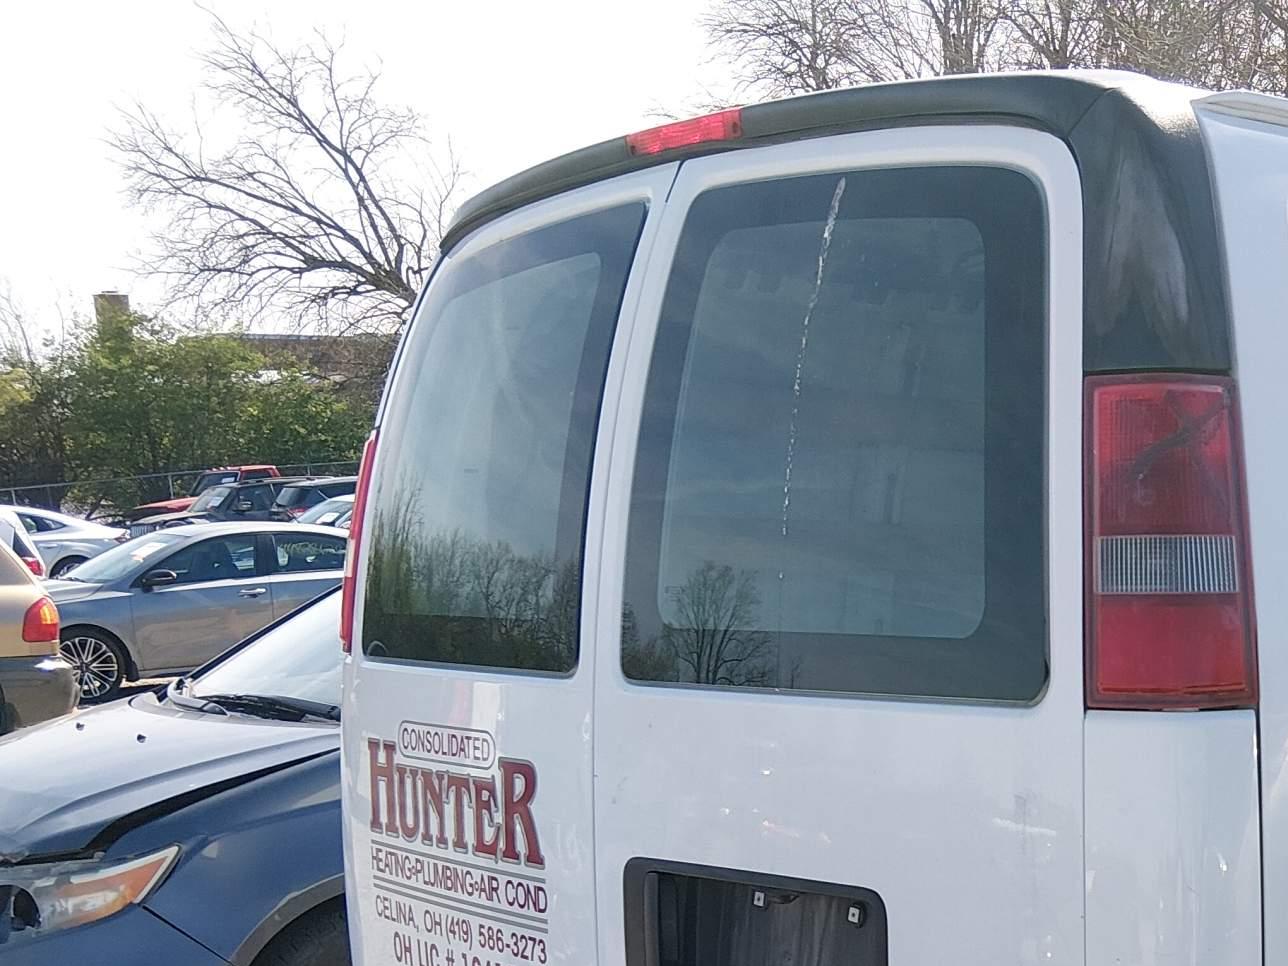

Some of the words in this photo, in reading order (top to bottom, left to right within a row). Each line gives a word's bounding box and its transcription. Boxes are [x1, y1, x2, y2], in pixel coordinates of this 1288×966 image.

[402, 727, 491, 762] CONSOLIDATED
[367, 738, 546, 869] HUNTER
[505, 880, 548, 913] COND
[375, 894, 420, 933] CELINA,
[423, 909, 443, 937] OH
[445, 914, 473, 951] (419)
[478, 923, 547, 965] 586-3273
[393, 931, 414, 966] OH
